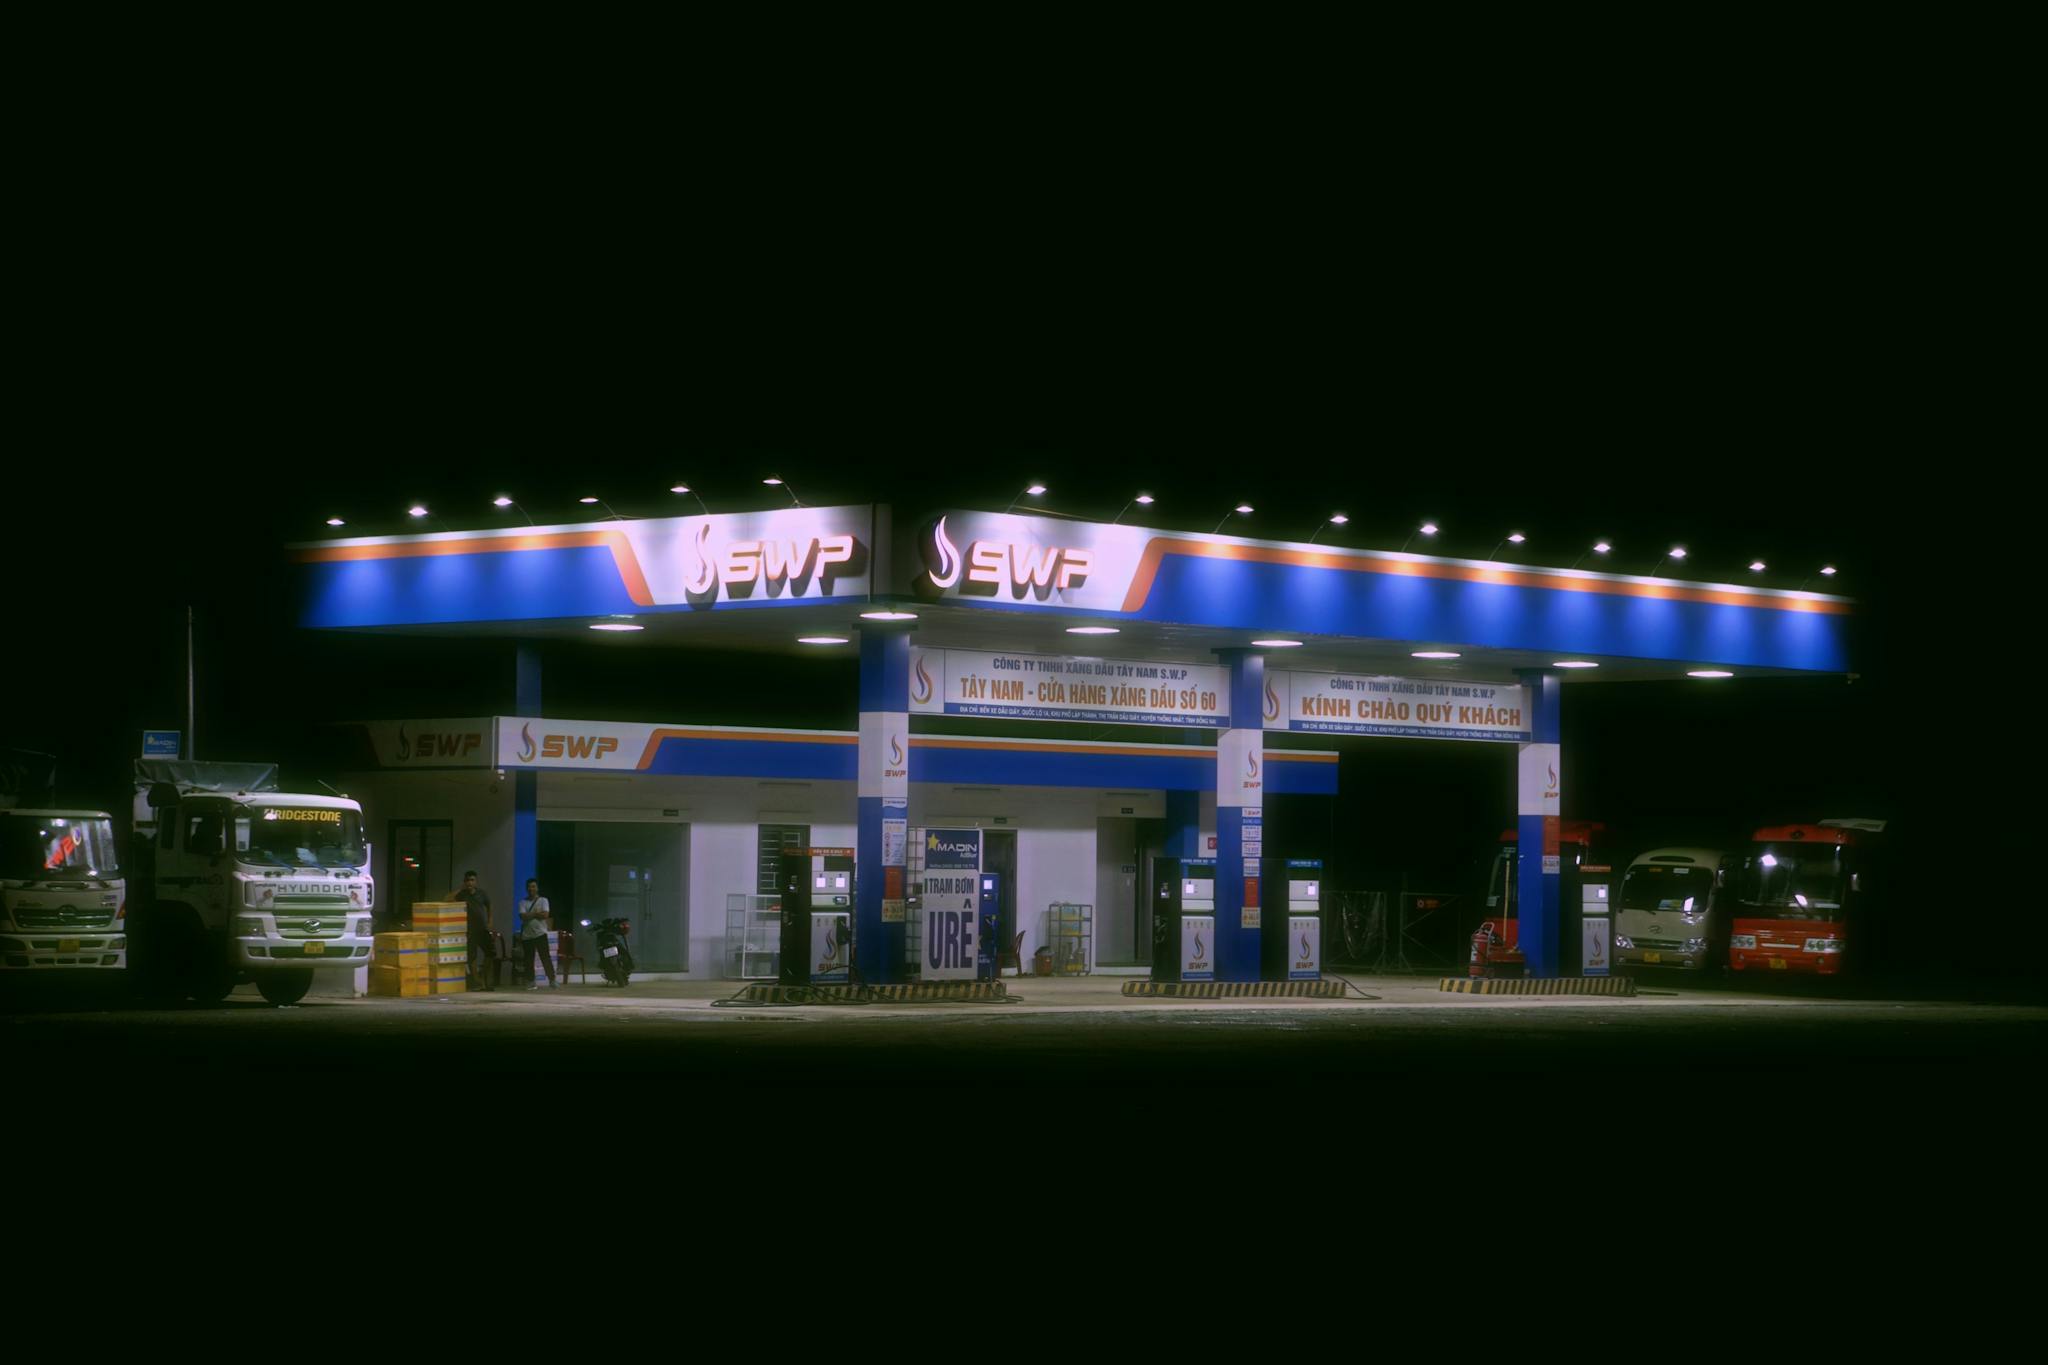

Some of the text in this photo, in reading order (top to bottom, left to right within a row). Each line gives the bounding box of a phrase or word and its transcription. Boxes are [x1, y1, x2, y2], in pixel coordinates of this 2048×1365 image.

[723, 535, 856, 587] SWP
[969, 539, 1096, 590] SWP
[994, 657, 1020, 671] CÔNG
[1024, 661, 1035, 672] TY
[1038, 661, 1063, 673] TNHH
[1117, 665, 1133, 677] TÂY
[1136, 667, 1158, 679] NAM
[1160, 669, 1188, 681] S.W.P
[960, 674, 987, 699] TÂY
[991, 680, 1024, 701] NAM
[1038, 676, 1066, 703] CỬA
[1069, 681, 1105, 705] HÀNG
[1110, 682, 1146, 708] XĂNG
[1180, 684, 1198, 710] SỐ
[1201, 692, 1216, 711] 60
[1330, 678, 1354, 690] CÔNG
[1357, 680, 1367, 692] TY
[1369, 682, 1390, 693] TNHH
[1451, 686, 1471, 698] NAM
[1302, 694, 1521, 727] KÍNH CHÀO QUÝ KHÁCH
[416, 733, 483, 758] SWP
[542, 735, 620, 760] SWP
[884, 769, 907, 778] SWP
[1242, 781, 1261, 789] SWP
[937, 843, 977, 852] MADIN
[278, 884, 347, 893] HYUNDAI
[929, 876, 975, 898] TRẠM BƠM
[929, 898, 974, 970] URÊ
[1188, 962, 1208, 970] SWP
